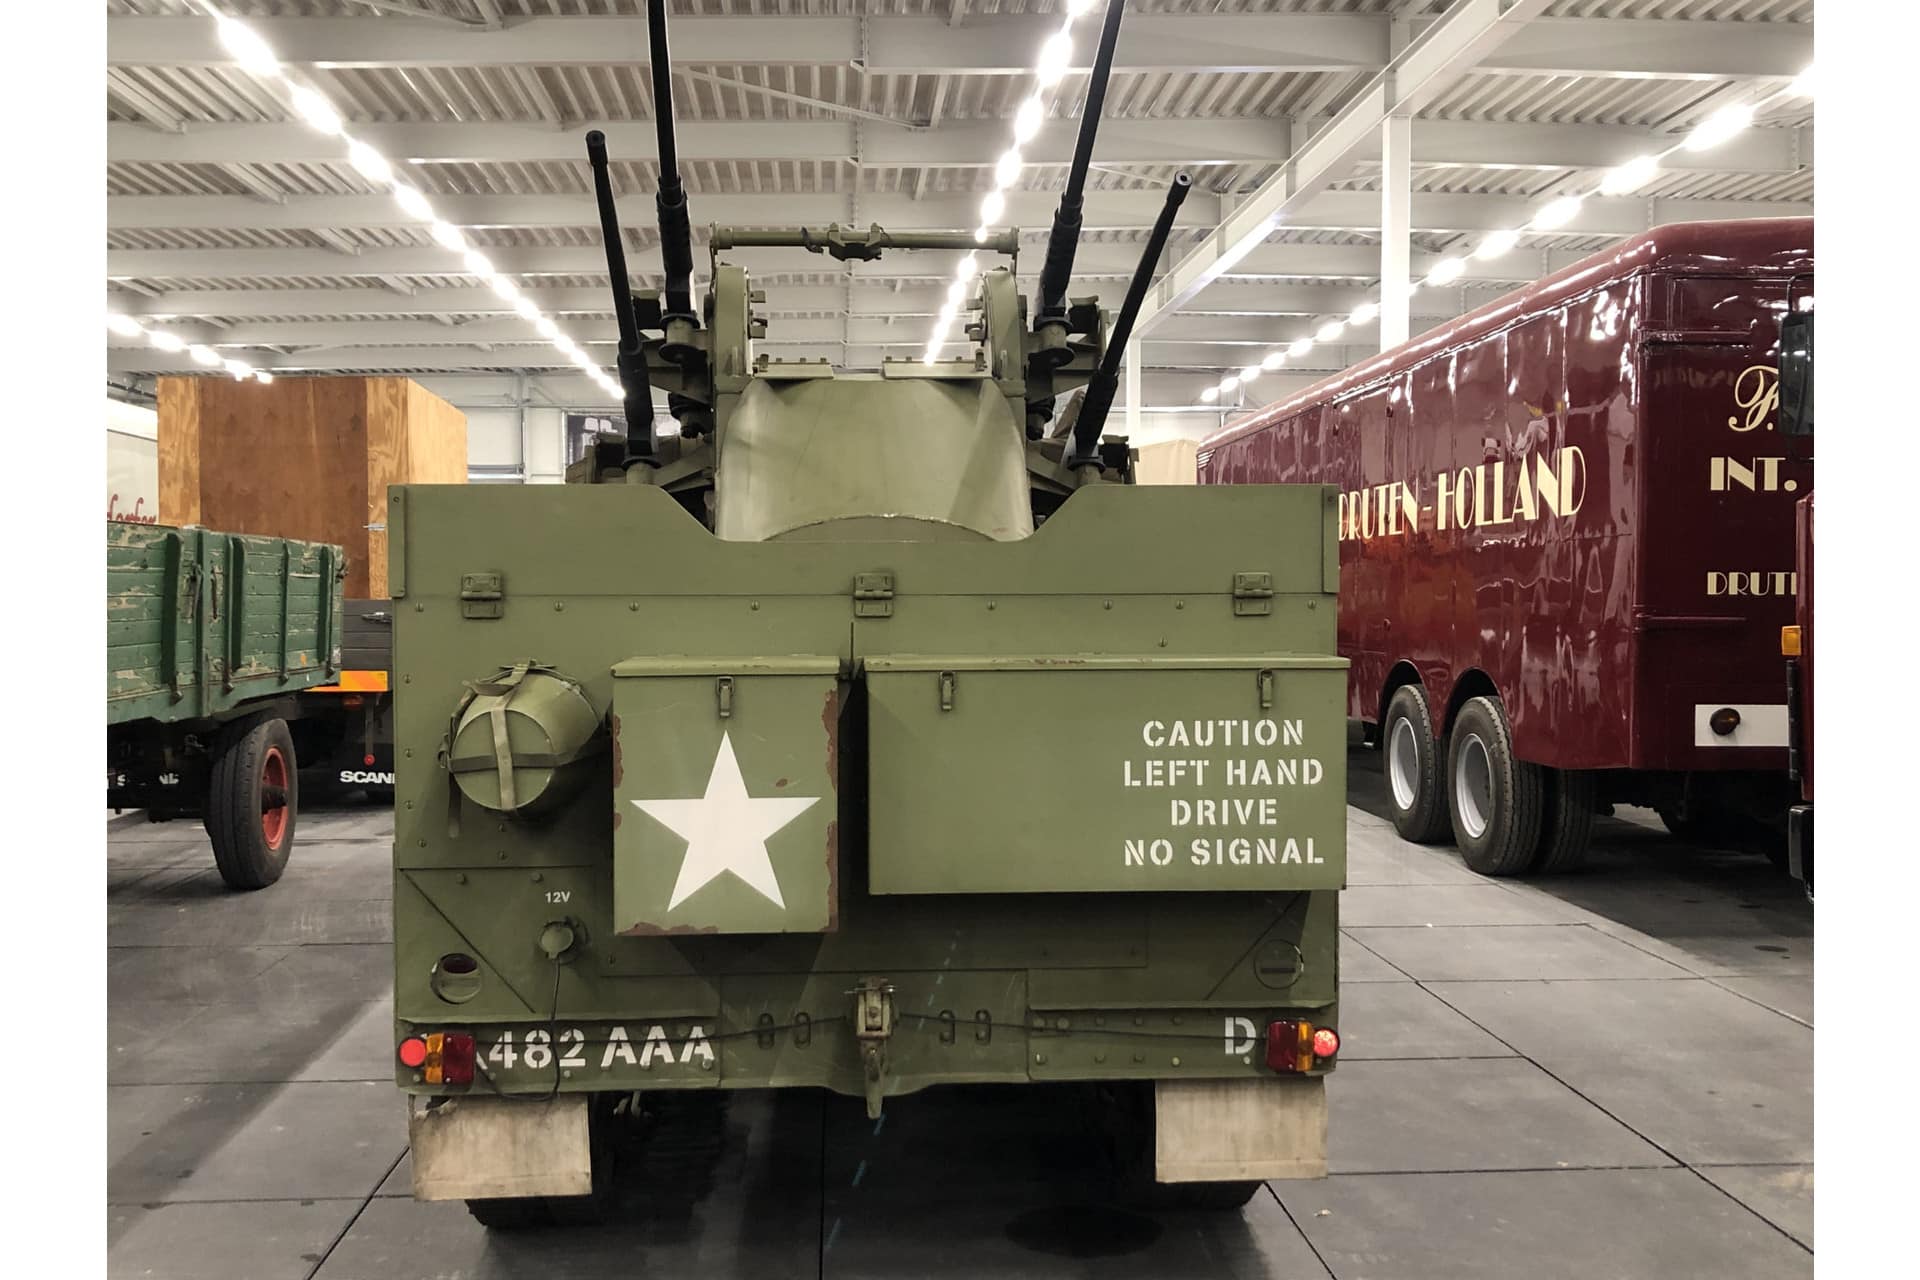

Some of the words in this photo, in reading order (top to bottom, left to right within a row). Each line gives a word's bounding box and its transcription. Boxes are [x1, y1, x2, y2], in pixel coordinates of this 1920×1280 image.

[1710, 456, 1798, 492] INT.
[1706, 571, 1797, 596] DRUT
[1143, 719, 1303, 747] CAUTION
[1124, 759, 1209, 786] LEFT
[1226, 758, 1323, 785] HAND
[1171, 798, 1277, 825] DRIVE
[1124, 839, 1173, 866] NO
[1190, 837, 1324, 865] SIGNAL
[545, 891, 571, 903] 12V
[476, 1029, 587, 1070] 482
[600, 1025, 715, 1068] AAA
[1224, 1016, 1257, 1055] D
